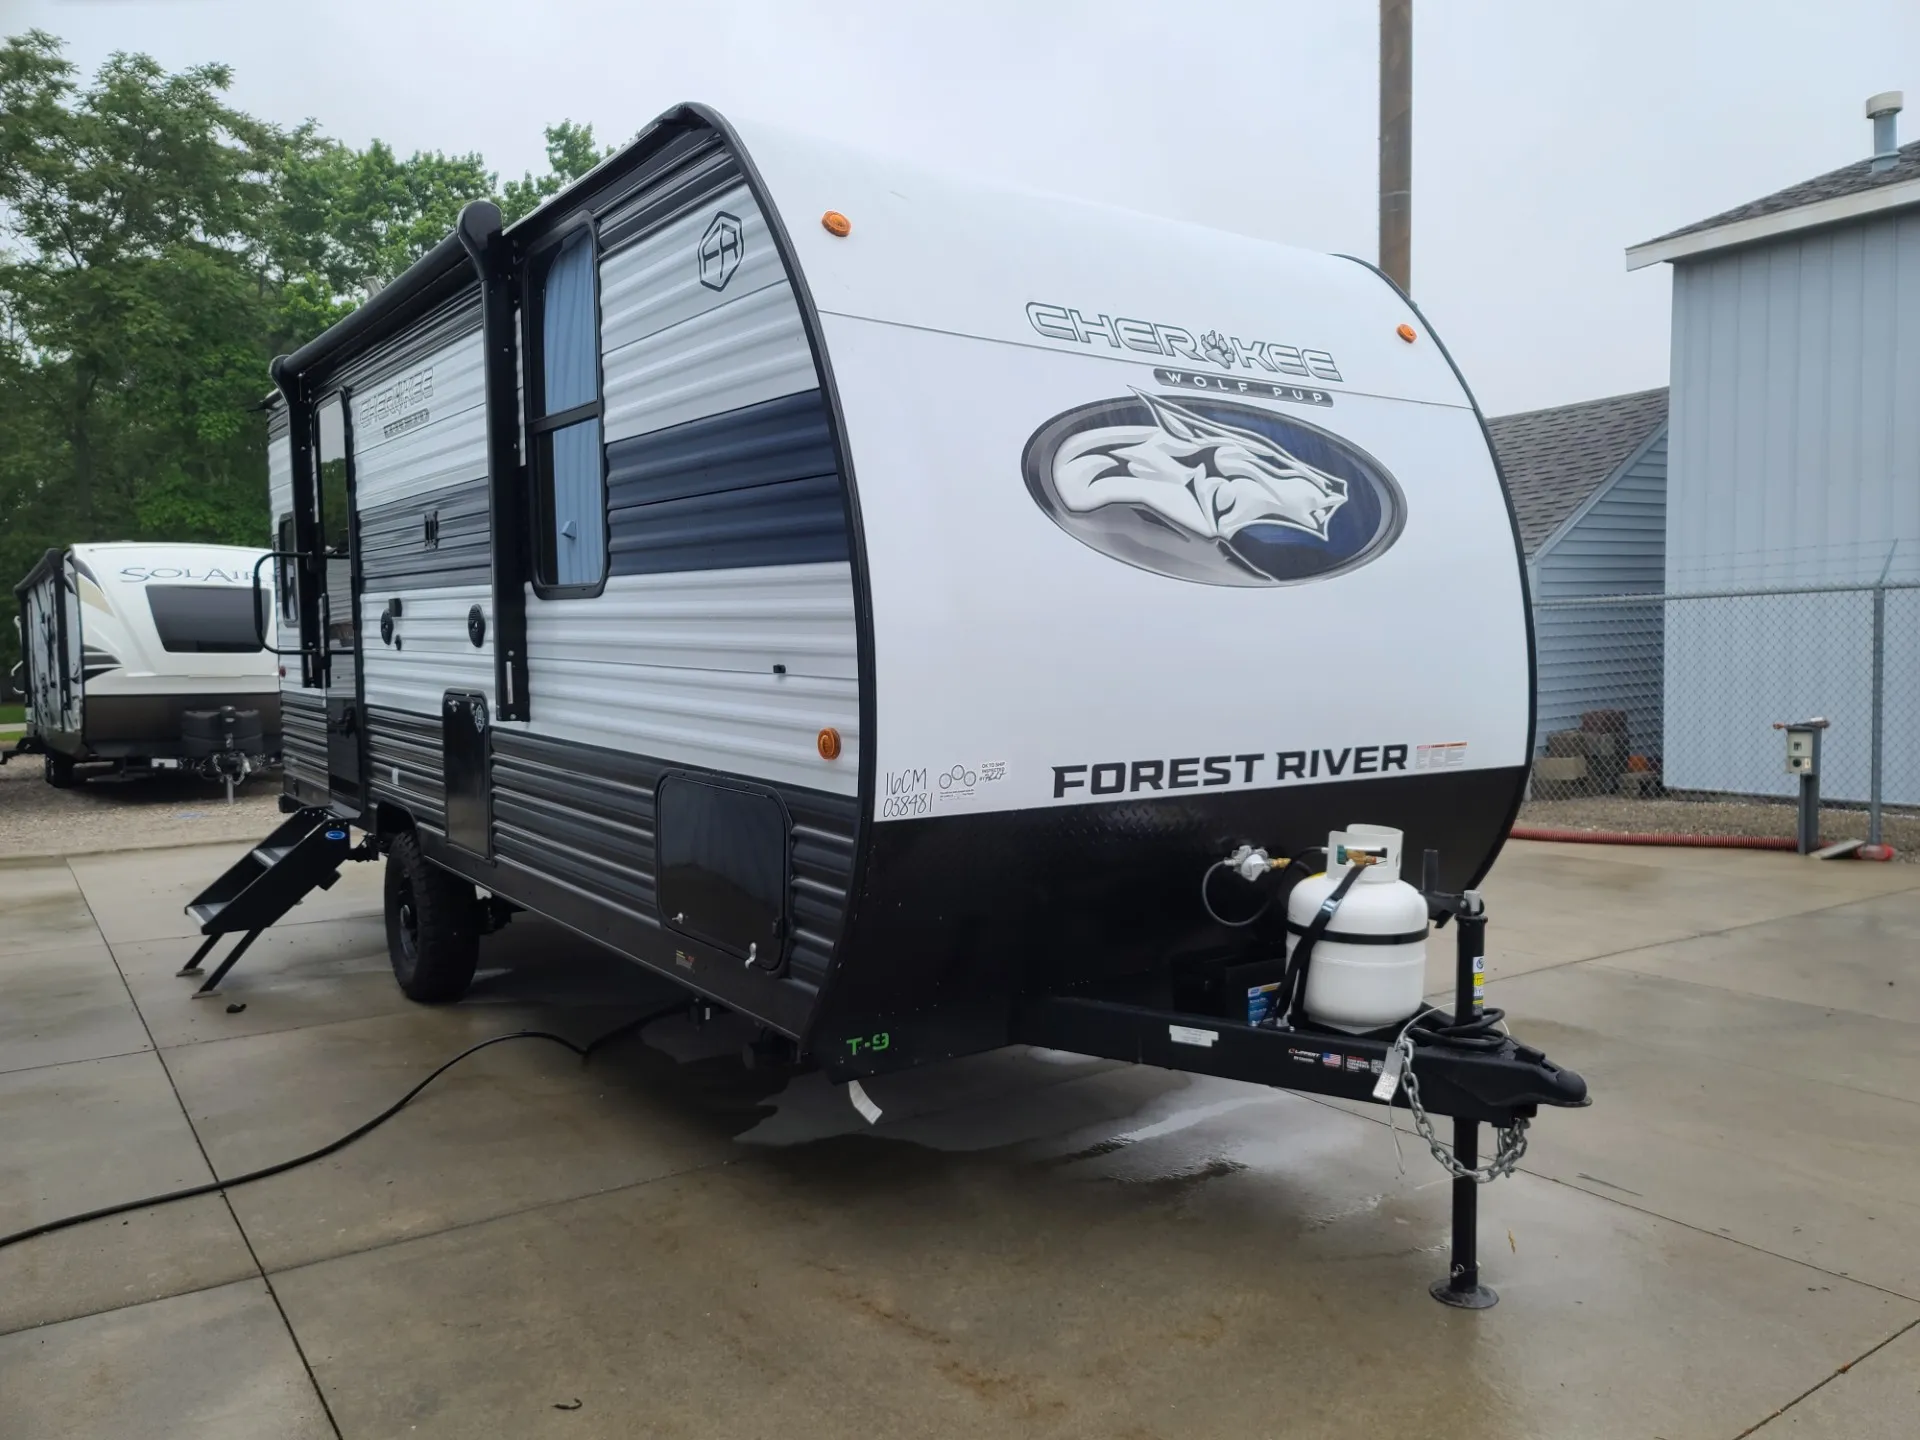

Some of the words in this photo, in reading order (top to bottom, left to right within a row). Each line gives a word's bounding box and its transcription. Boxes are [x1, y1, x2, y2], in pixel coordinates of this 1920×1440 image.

[1165, 372, 1248, 393] WOLF
[1272, 387, 1323, 403] PUP
[1051, 753, 1265, 798] FOREST
[1276, 744, 1408, 780] RIVER
[883, 792, 933, 817] 038481
